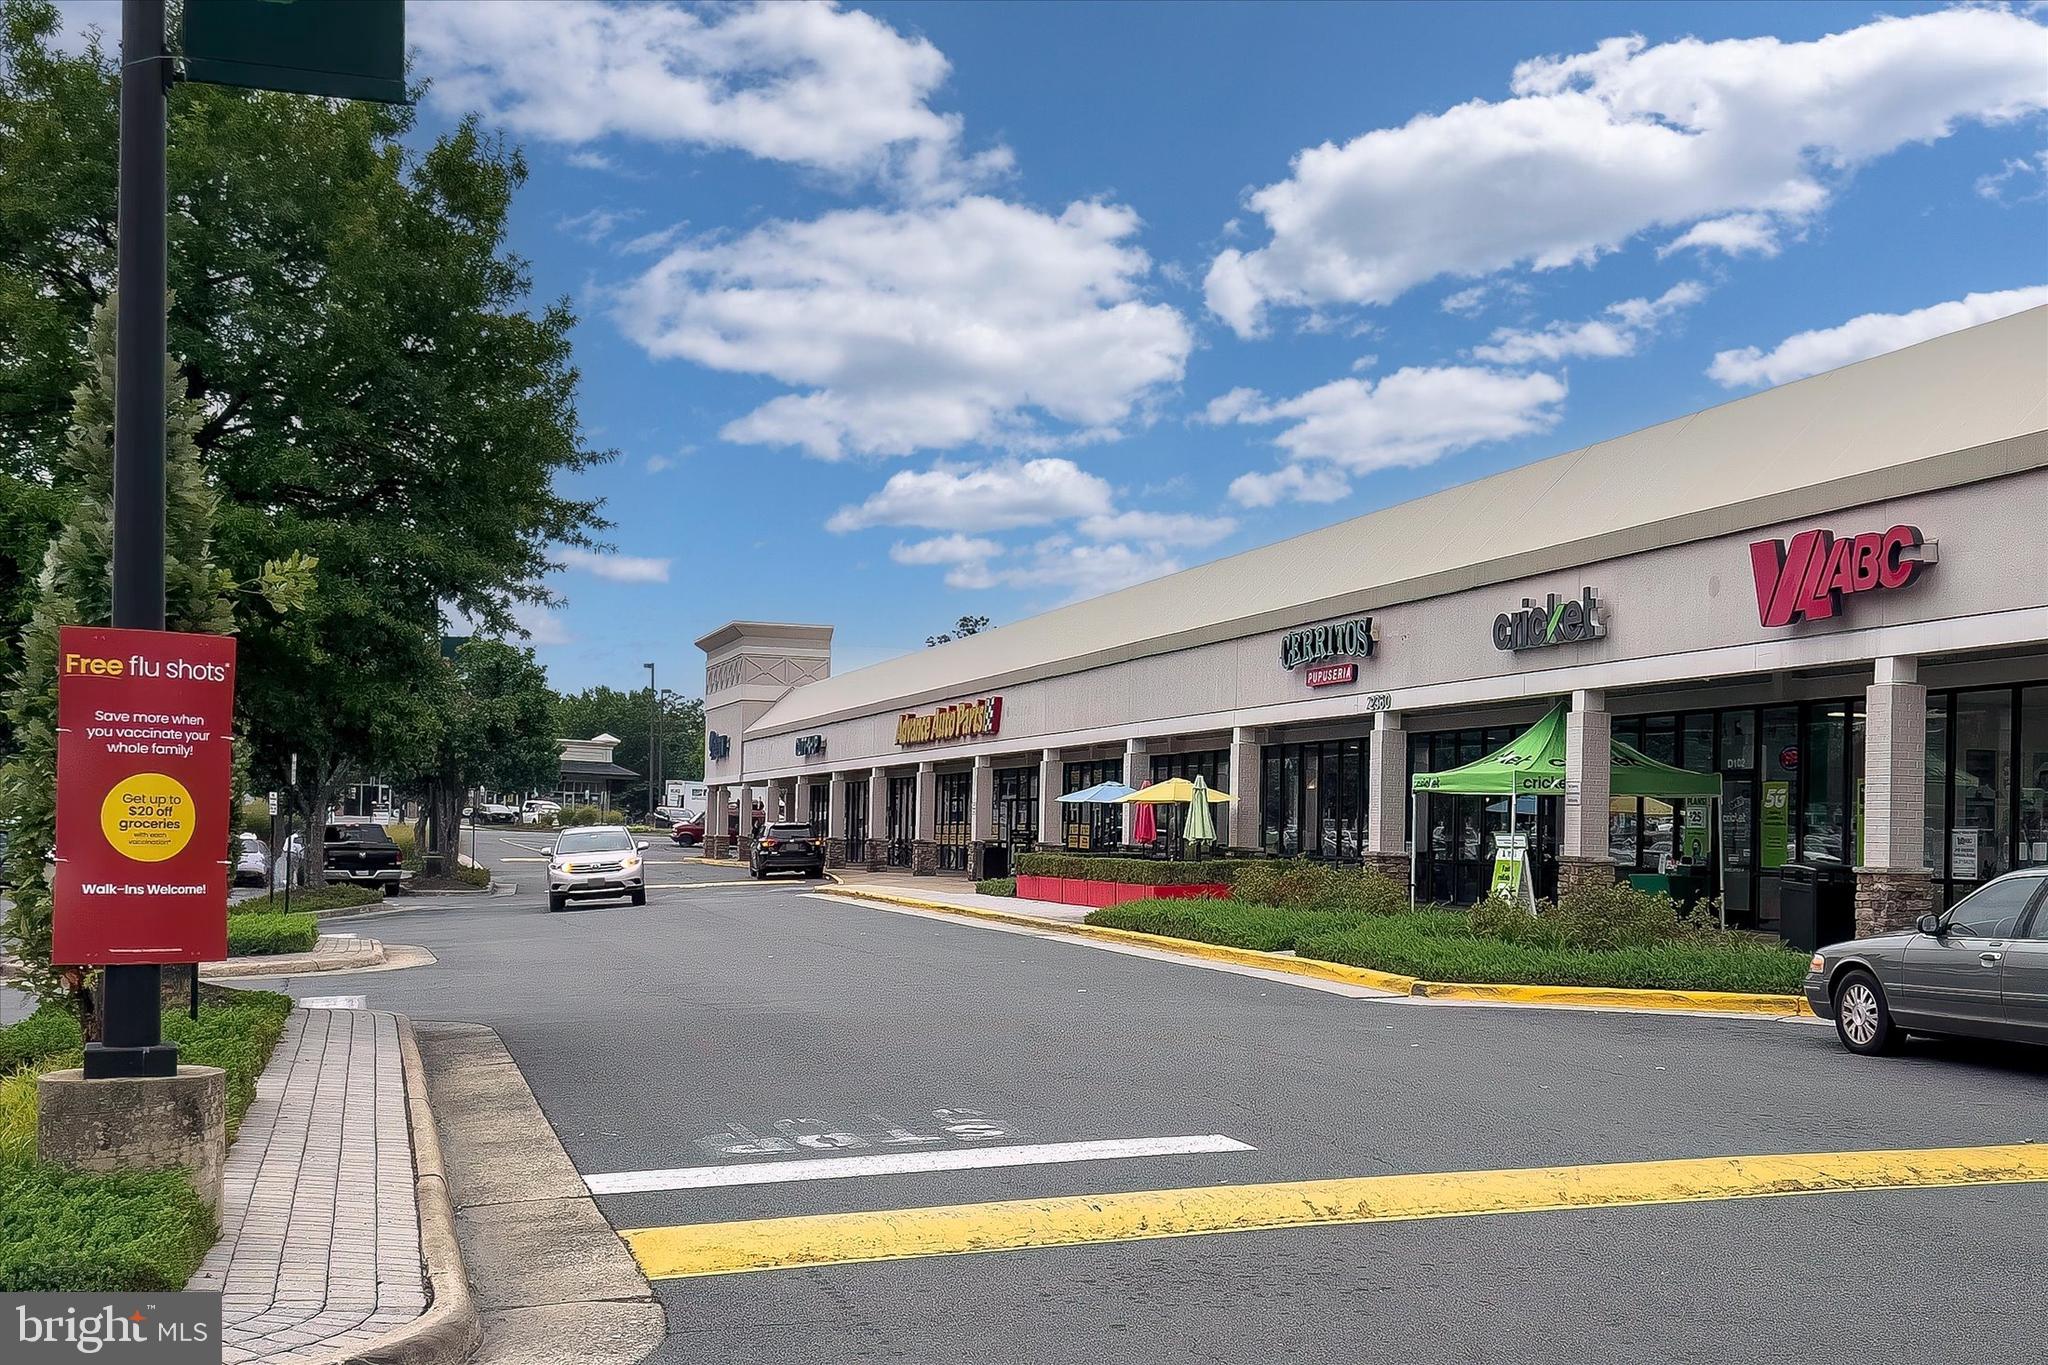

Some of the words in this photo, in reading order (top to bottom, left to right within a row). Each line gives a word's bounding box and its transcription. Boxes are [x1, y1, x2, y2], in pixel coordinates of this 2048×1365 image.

[1493, 586, 1598, 650] cricket
[1281, 616, 1373, 671] CERRITOS
[65, 653, 124, 676] Free
[129, 655, 161, 677] flu
[1307, 666, 1352, 684] PUPUSERIA
[94, 710, 131, 722] Save
[132, 713, 170, 724] more
[171, 713, 205, 726] when
[896, 714, 932, 745] Advance
[931, 706, 958, 741] Auto
[956, 700, 986, 737] Parts
[86, 727, 113, 739] you
[116, 727, 183, 740] vaccinate
[185, 731, 211, 744] your
[107, 742, 149, 754] whole
[151, 743, 194, 758] family!
[1522, 776, 1566, 791] cricke
[122, 793, 146, 804] Get
[149, 796, 167, 808] up
[169, 794, 182, 805] to
[1764, 788, 1787, 808] 5G
[128, 806, 153, 816] $20
[156, 806, 173, 817] off
[119, 818, 181, 831] groceries
[82, 884, 145, 895] Walk-Ins
[147, 884, 207, 895] Welcome!
